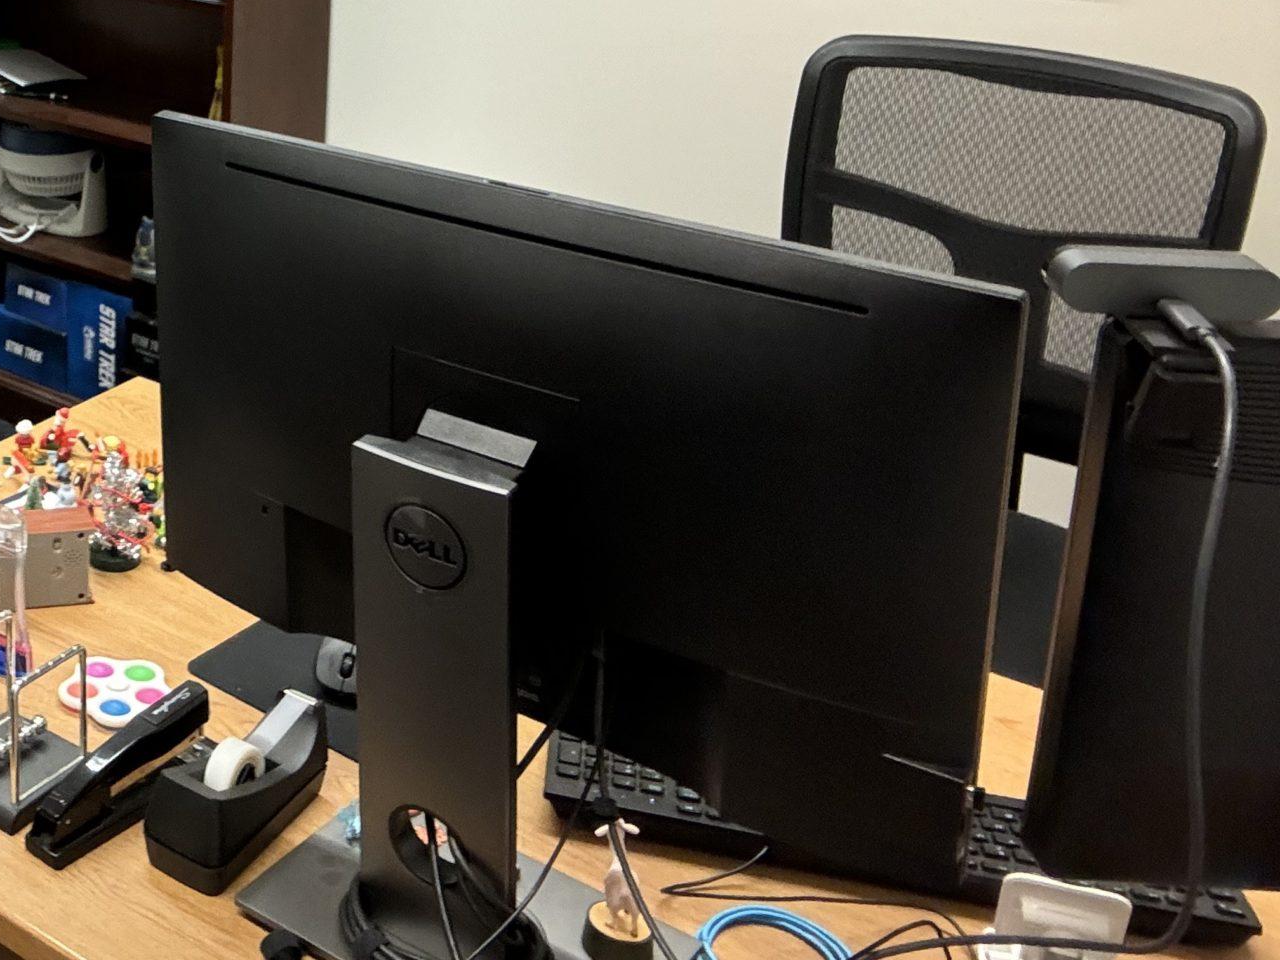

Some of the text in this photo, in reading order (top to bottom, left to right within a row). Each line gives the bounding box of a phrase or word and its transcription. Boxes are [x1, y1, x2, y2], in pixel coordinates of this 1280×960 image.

[98, 303, 116, 388] STAR TREK
[392, 528, 458, 568] DELL
